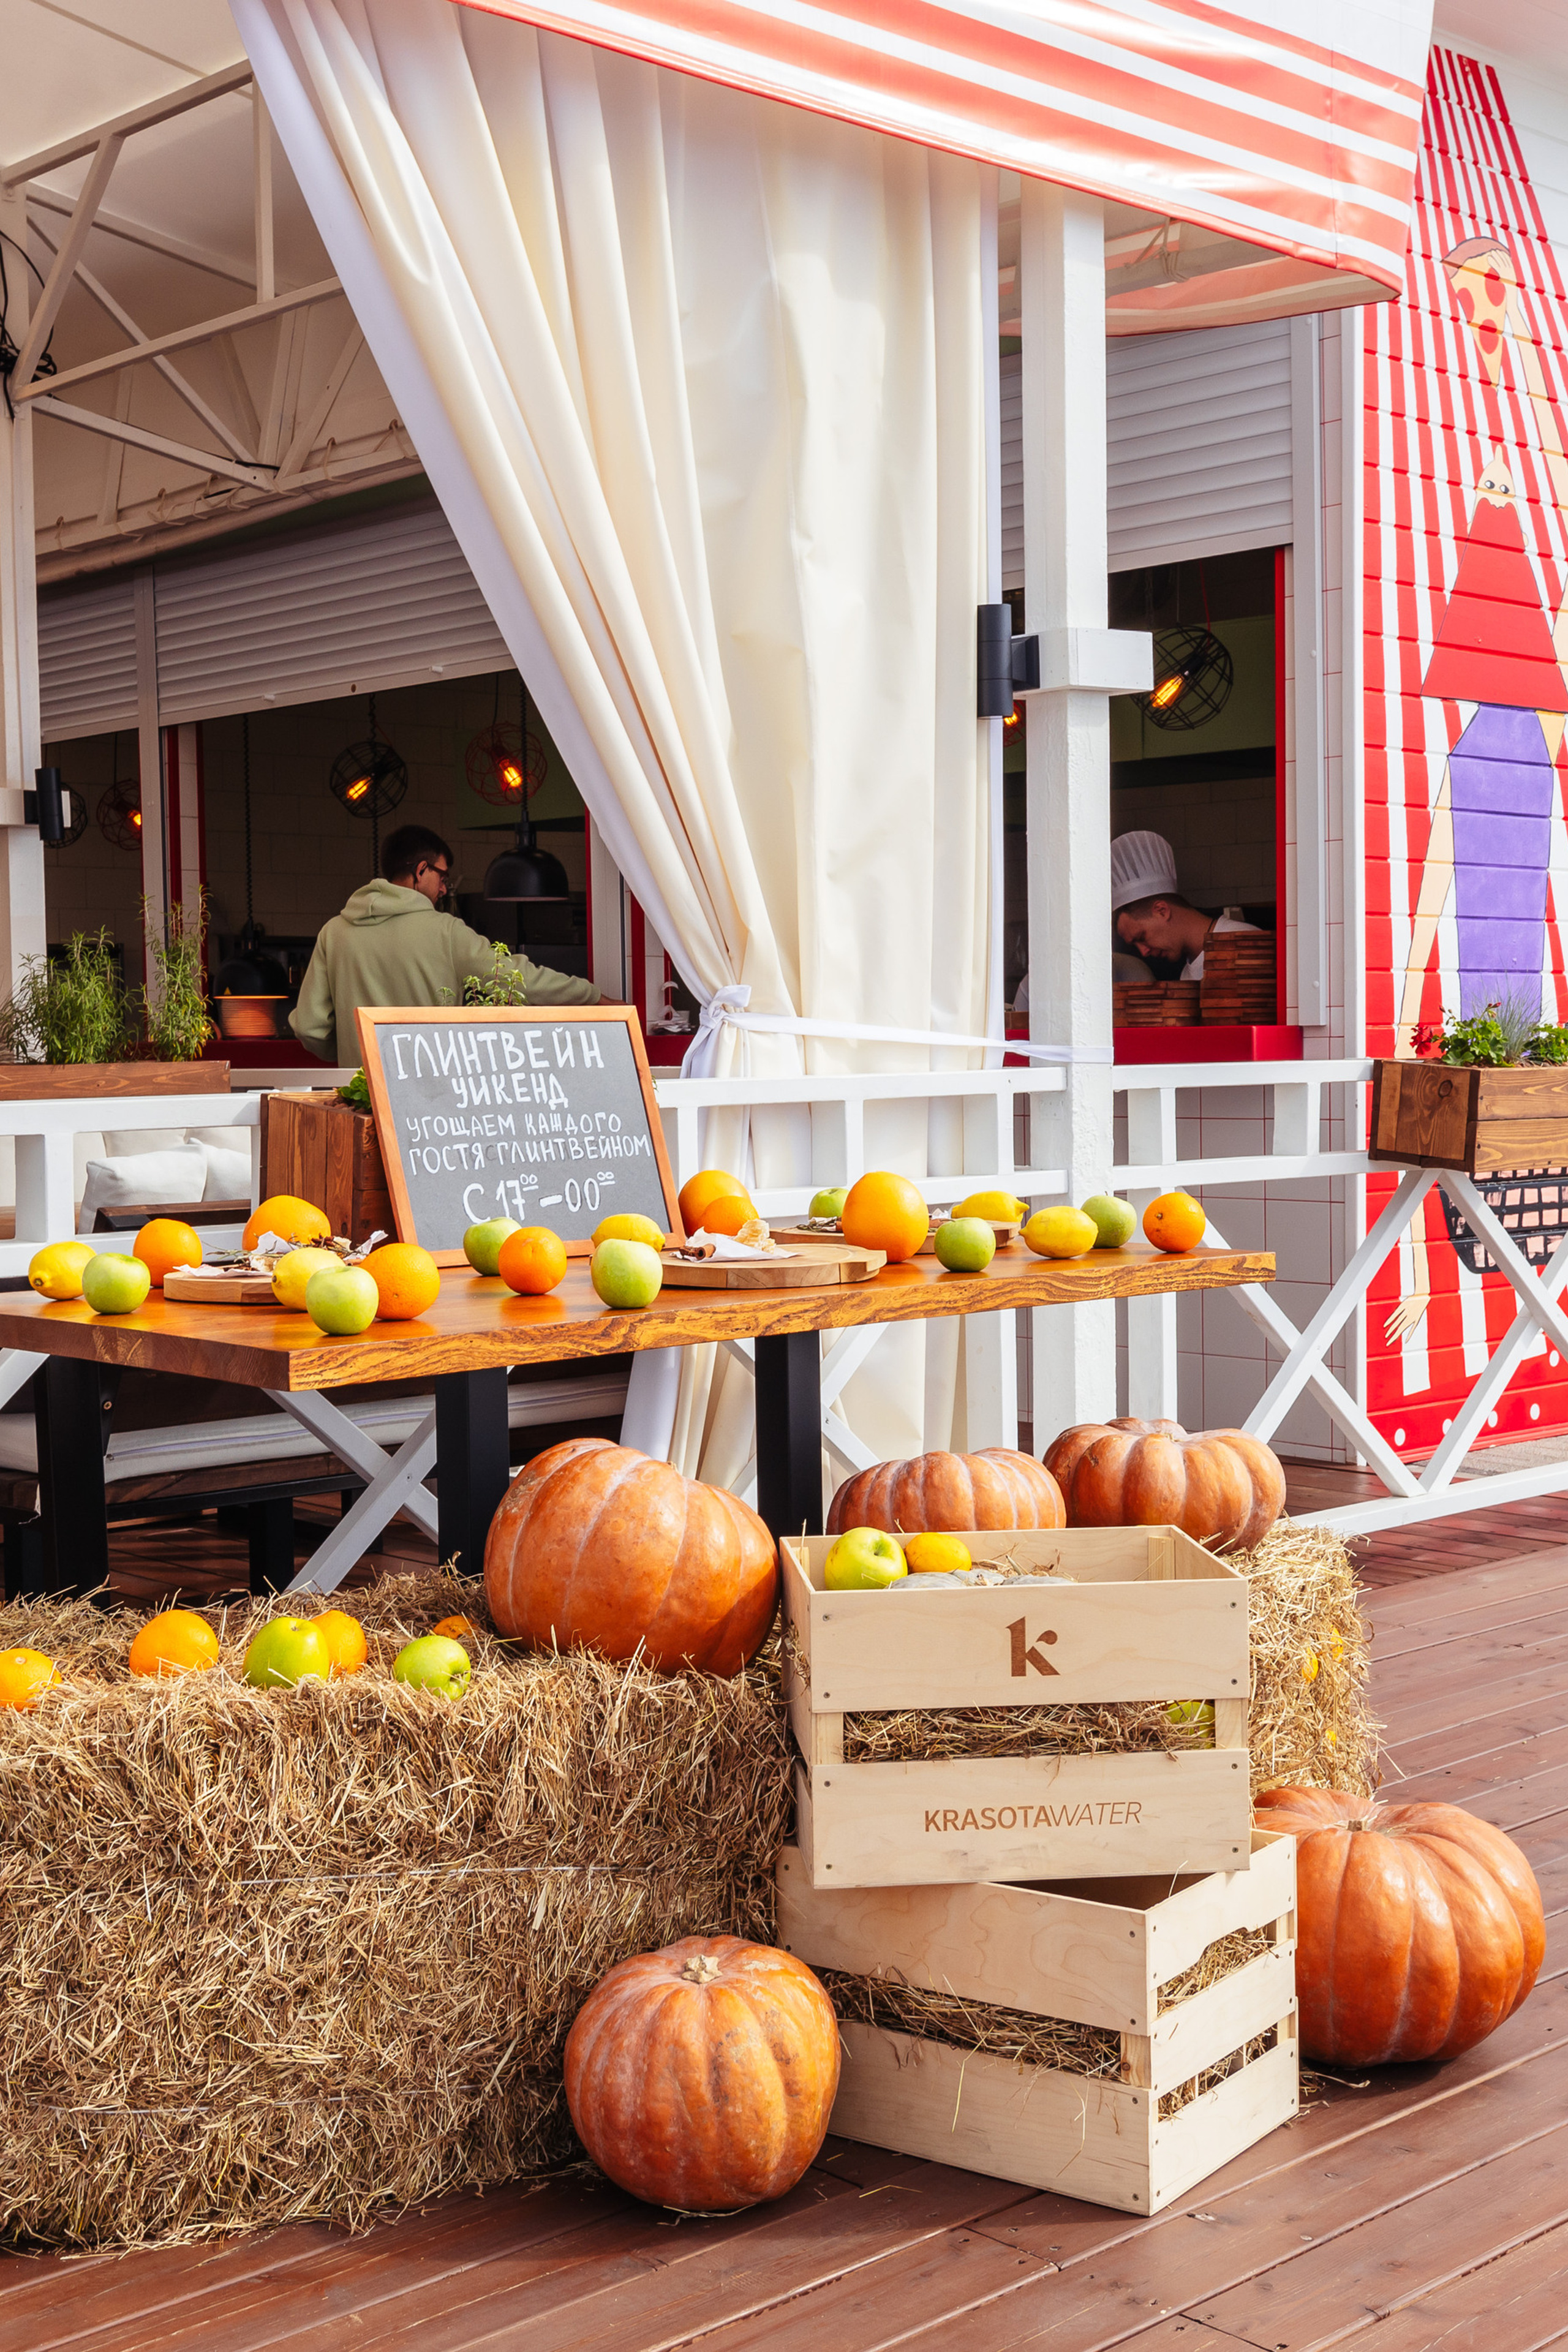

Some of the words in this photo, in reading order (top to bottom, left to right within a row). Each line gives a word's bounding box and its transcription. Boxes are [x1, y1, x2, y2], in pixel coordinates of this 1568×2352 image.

[391, 1026, 605, 1080] ГЛИНТВЕЙН
[450, 1072, 570, 1111] УИКЕНД
[405, 1113, 516, 1142] УГОЩАЕМ
[524, 1111, 622, 1137] КАЖДОГО
[408, 1142, 486, 1176] ГОСТЯ
[496, 1133, 652, 1166] ГЛИНТВЕЙНОМ
[925, 1801, 1142, 1833] KRASOTAWATER
